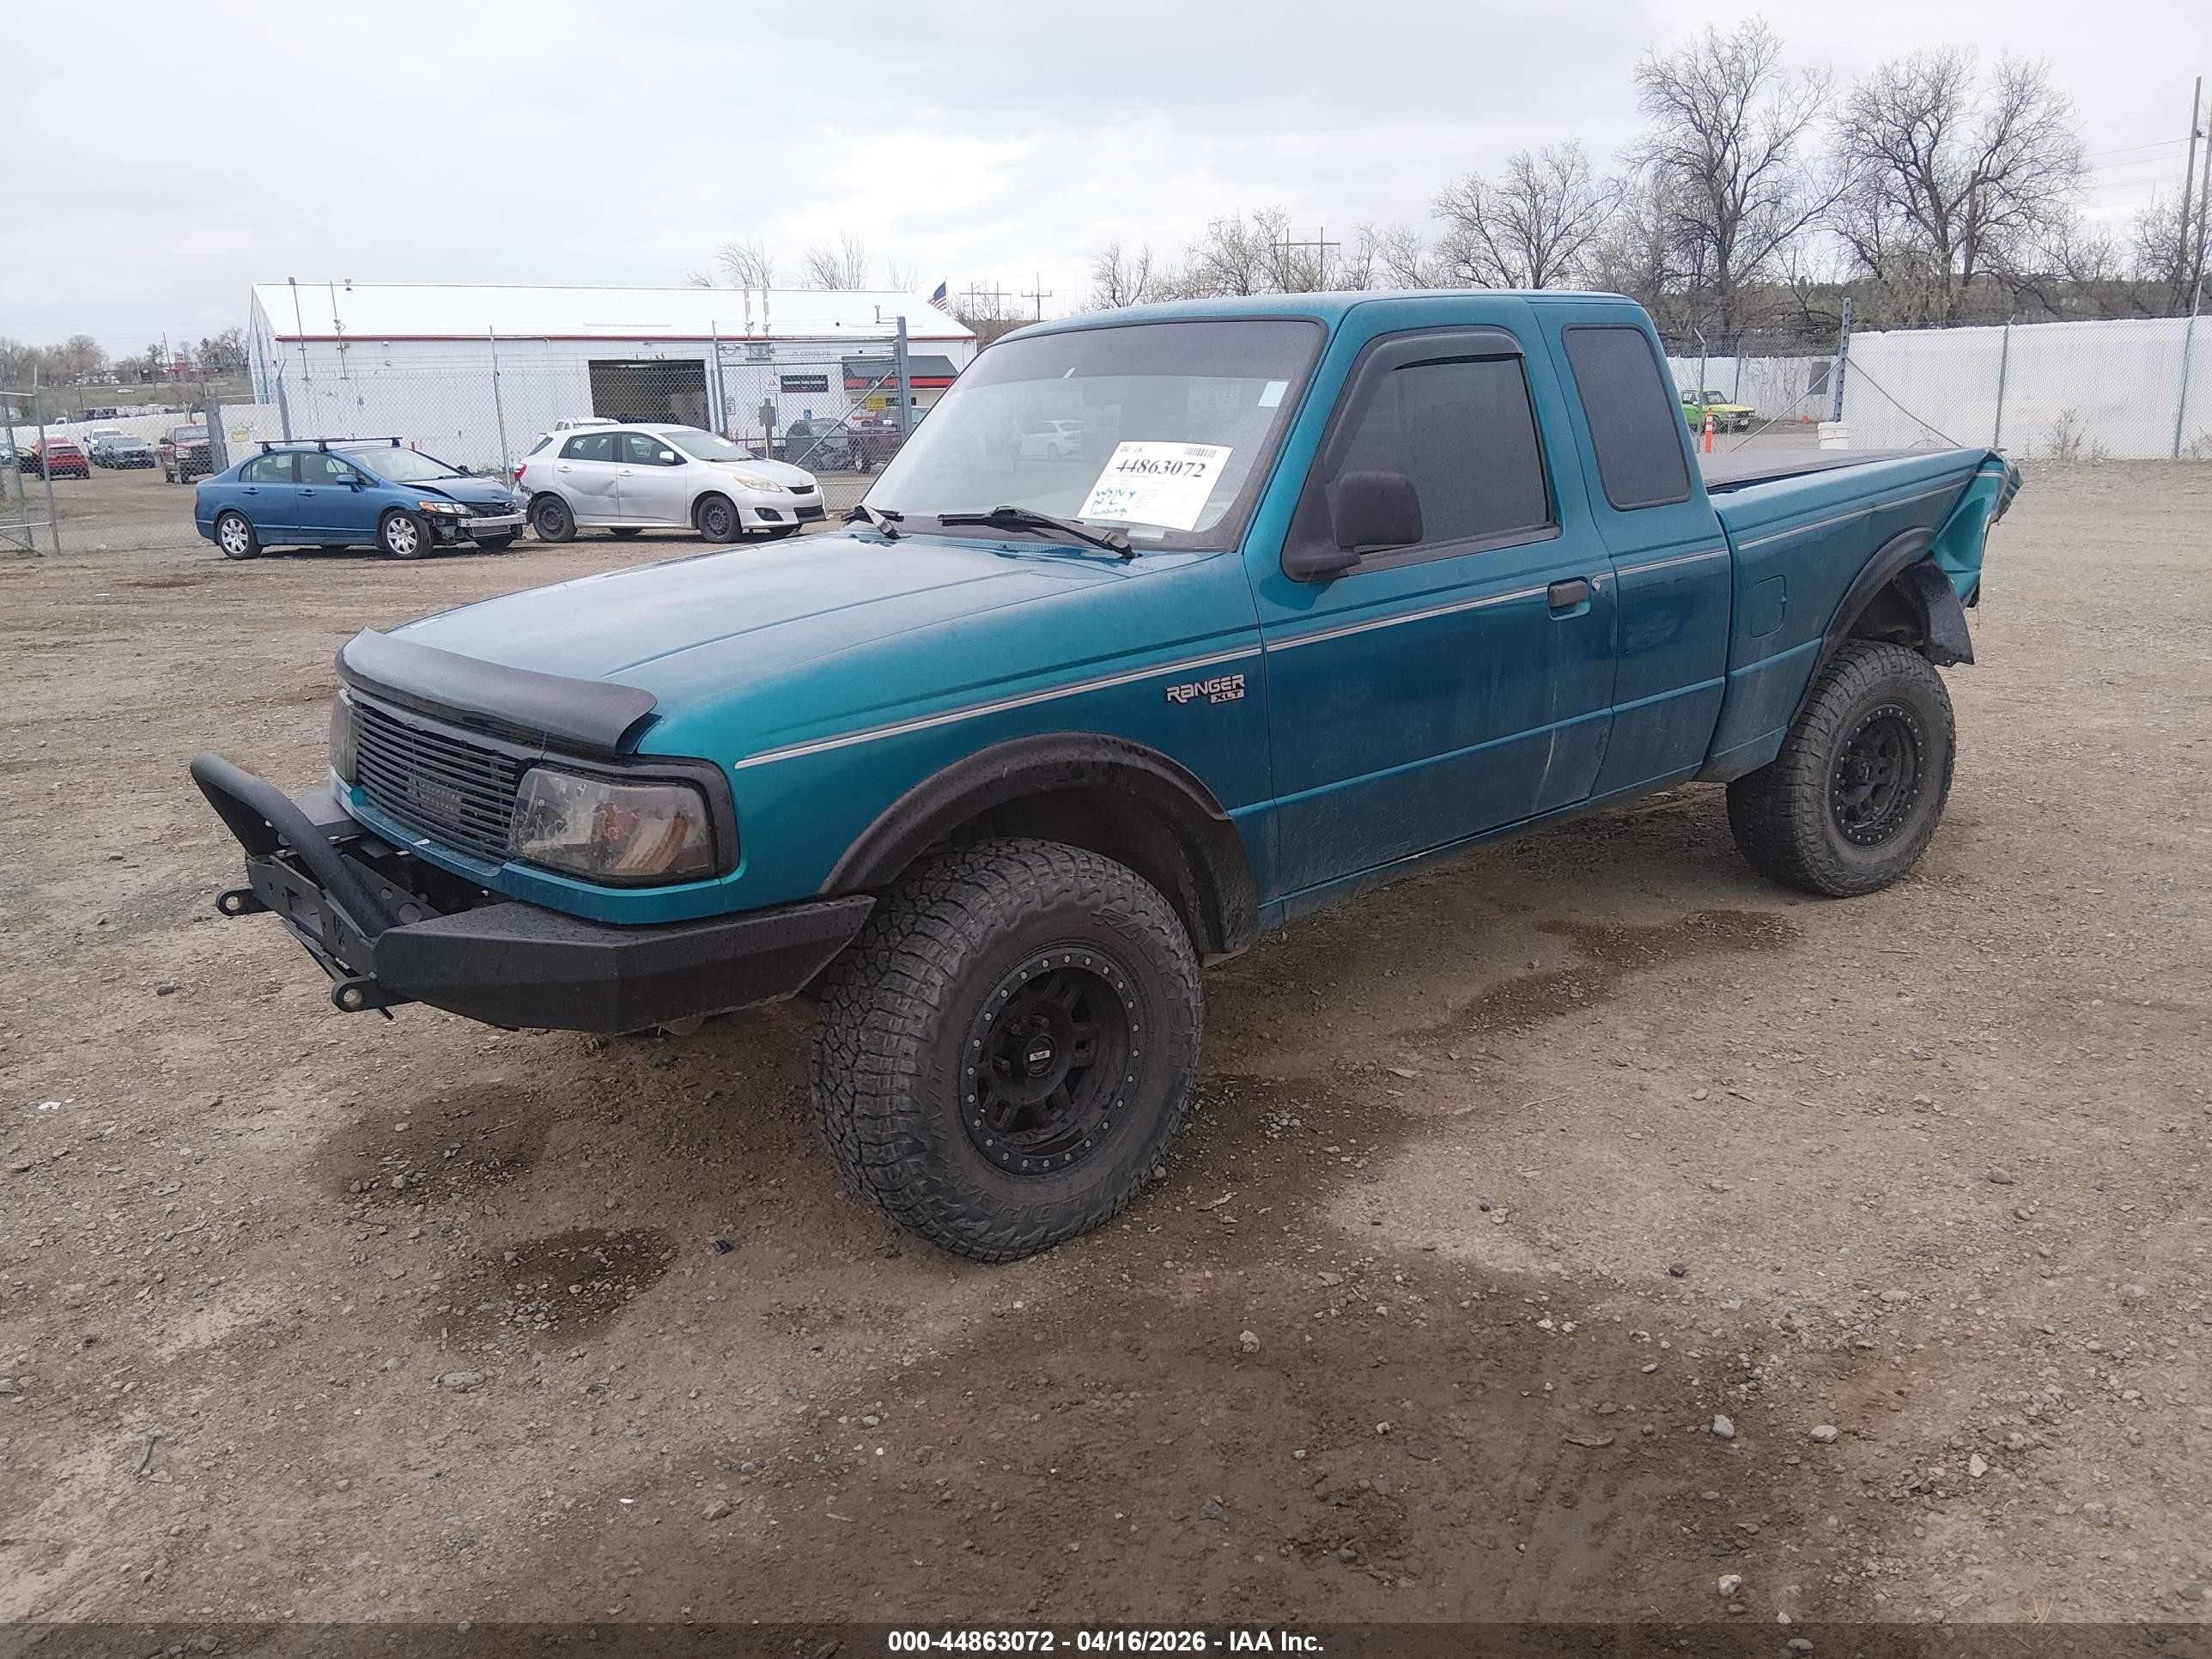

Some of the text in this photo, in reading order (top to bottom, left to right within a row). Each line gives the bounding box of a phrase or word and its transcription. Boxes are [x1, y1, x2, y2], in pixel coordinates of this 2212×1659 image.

[1115, 458, 1206, 477] 44863072
[1166, 674, 1245, 703] RANGER
[1213, 690, 1243, 702] XLT
